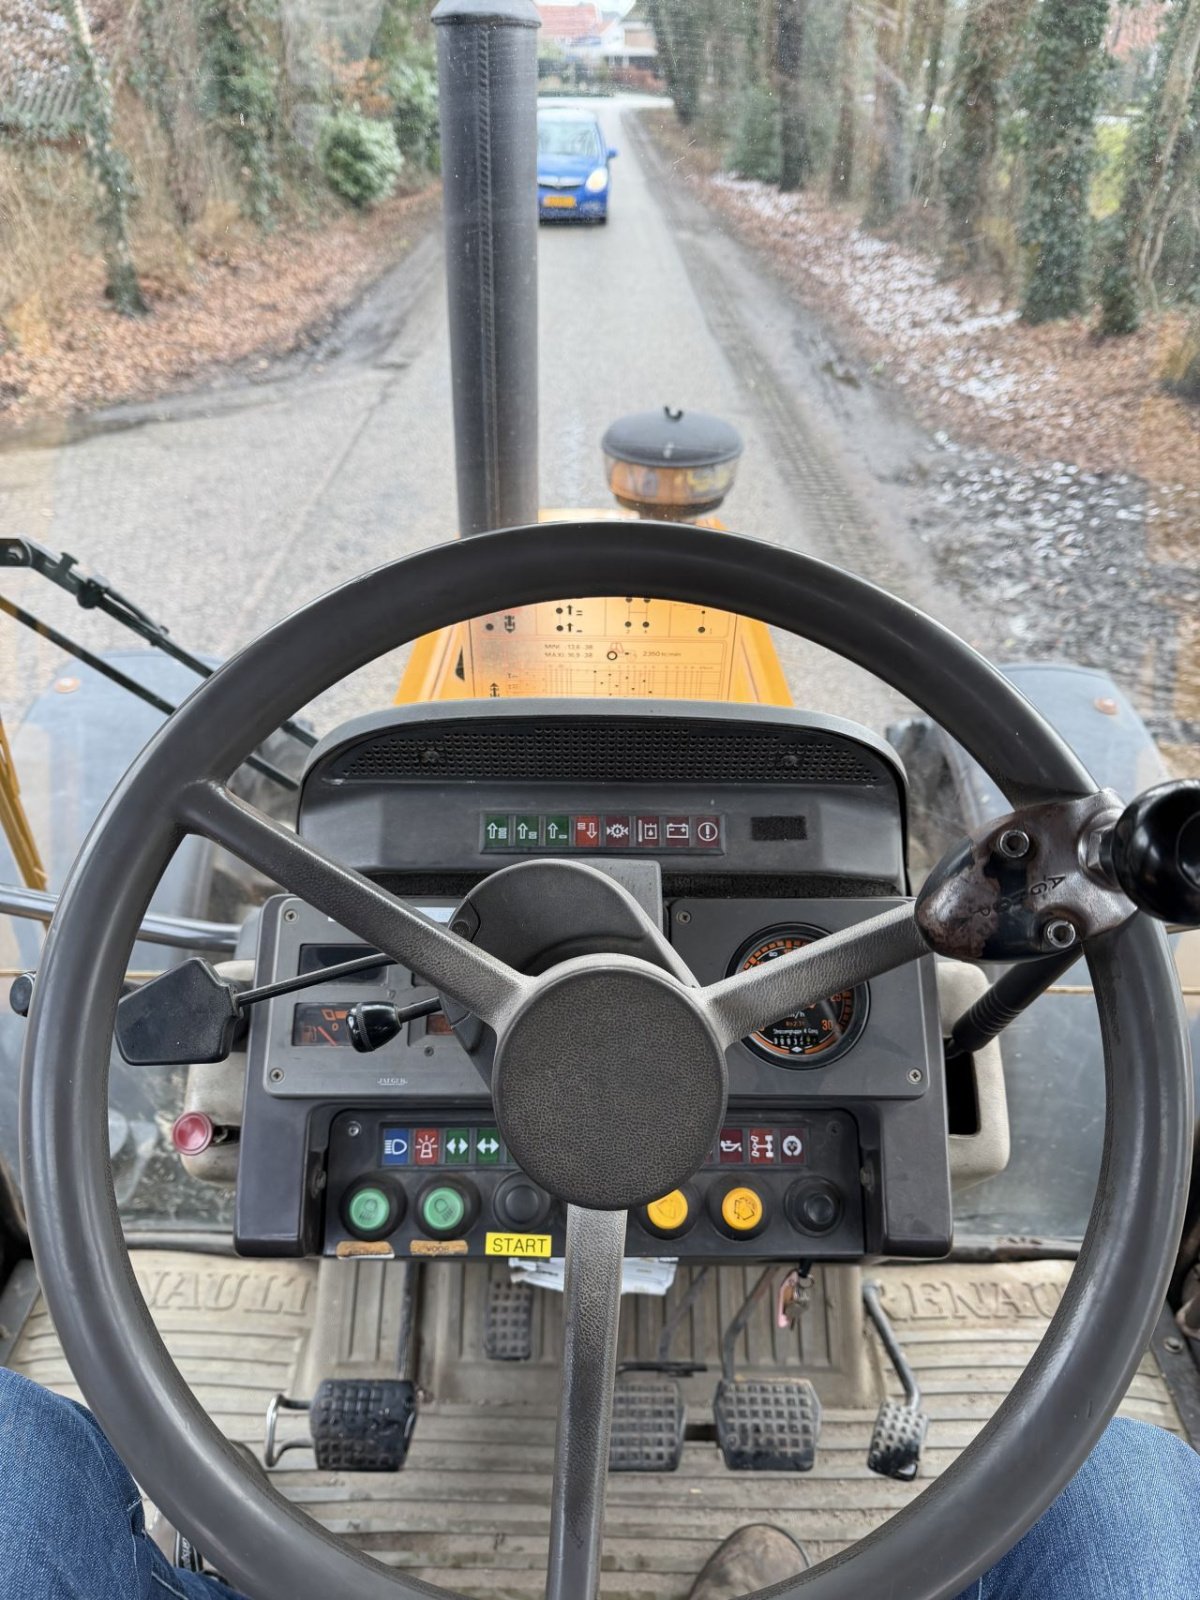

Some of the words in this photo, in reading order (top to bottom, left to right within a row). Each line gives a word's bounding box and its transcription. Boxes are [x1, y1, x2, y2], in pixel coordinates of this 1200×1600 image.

[821, 1019, 834, 1031] 30
[493, 1237, 548, 1253] START
[142, 1268, 312, 1316] NAULT
[878, 1281, 1068, 1322] RENAU
